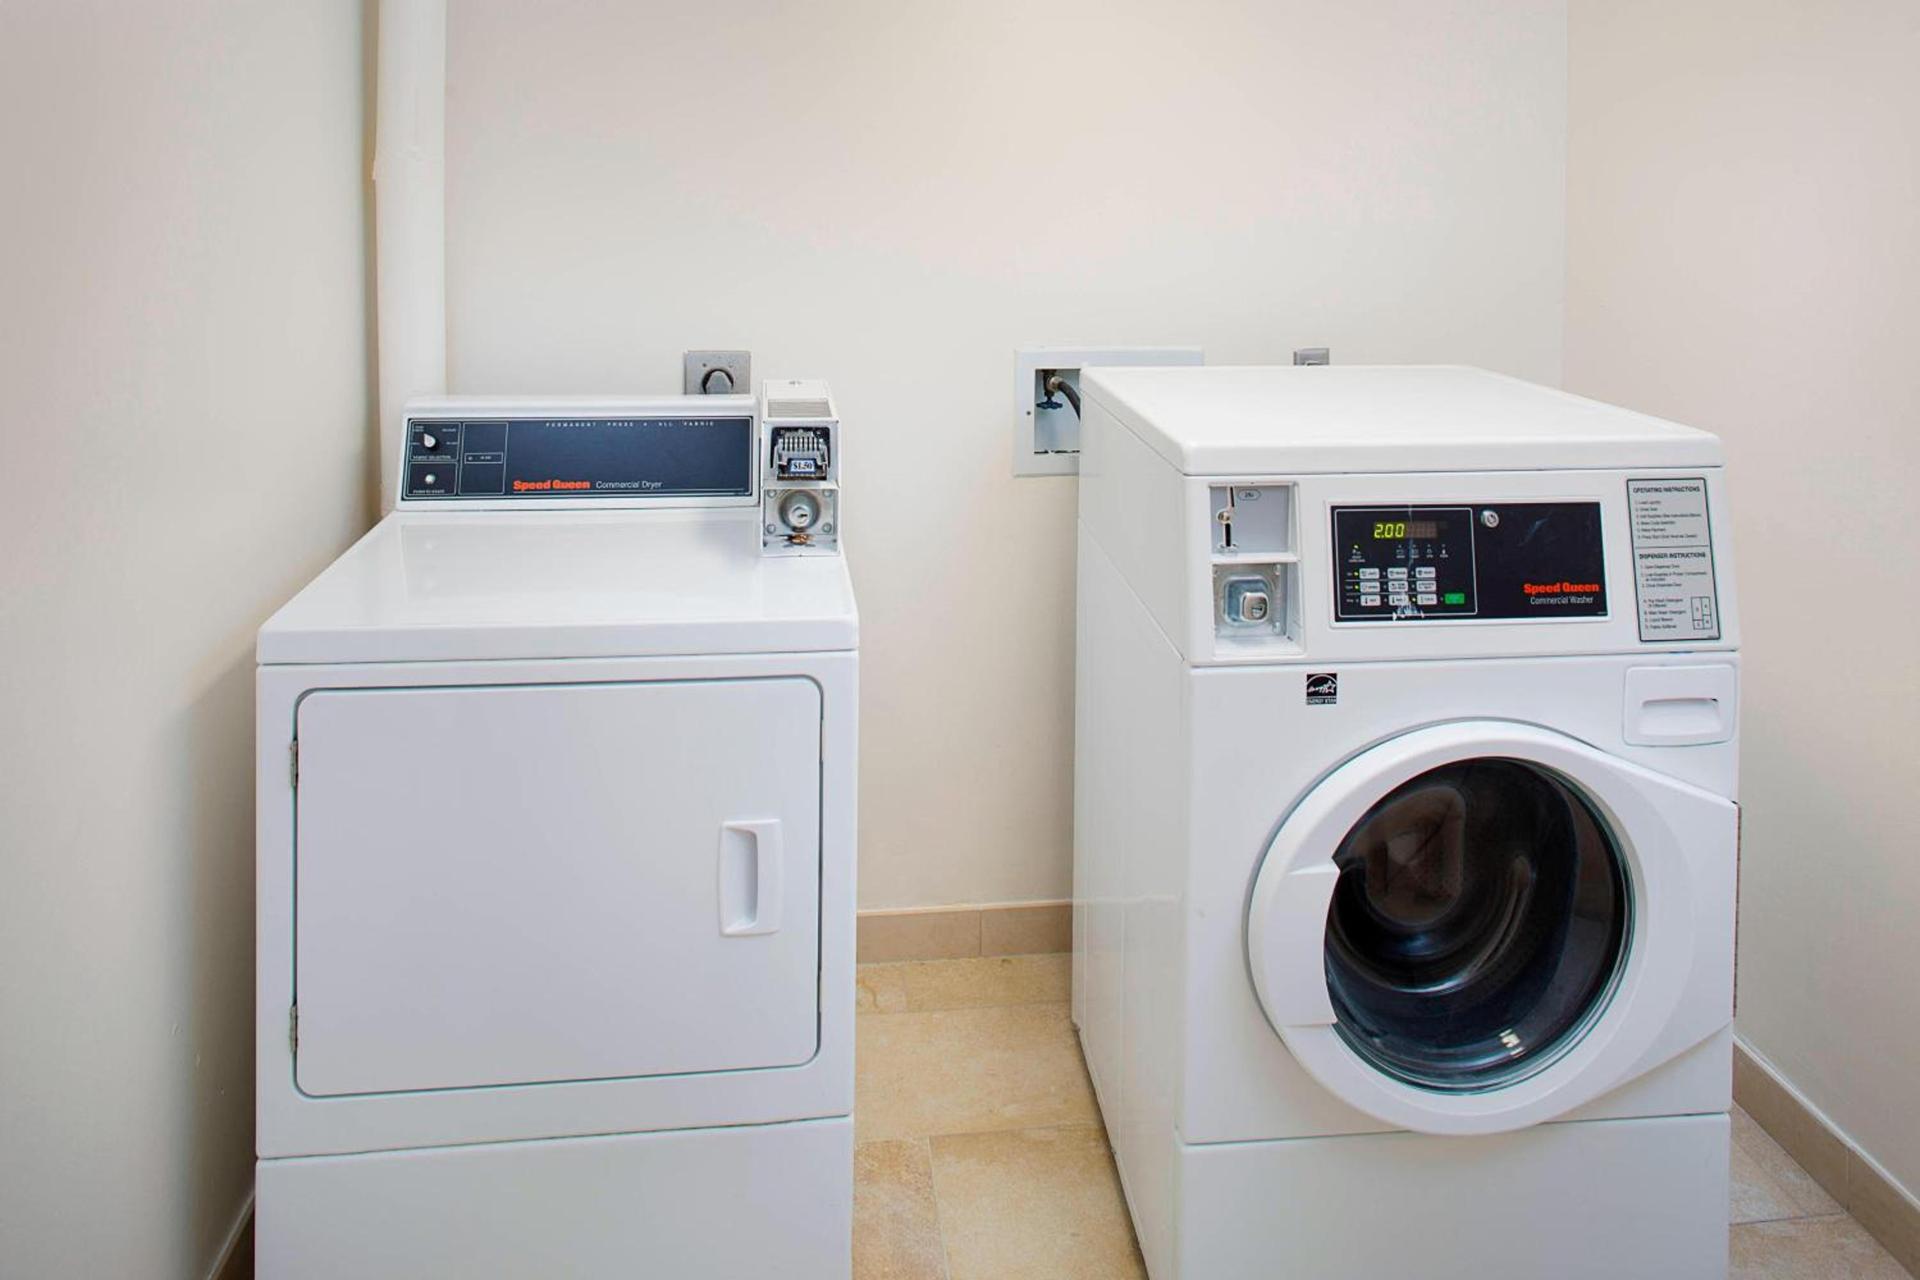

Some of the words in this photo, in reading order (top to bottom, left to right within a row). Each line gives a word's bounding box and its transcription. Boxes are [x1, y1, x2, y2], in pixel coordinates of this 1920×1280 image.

[513, 480, 551, 491] Speed
[552, 479, 591, 490] Queen
[595, 480, 640, 489] Commercial
[642, 480, 663, 490] Dryer
[1373, 523, 1405, 539] 2.00
[1523, 582, 1561, 596] Speed
[1562, 582, 1600, 593] Queen
[1530, 595, 1569, 605] Commercial
[1569, 595, 1594, 604] Washer
